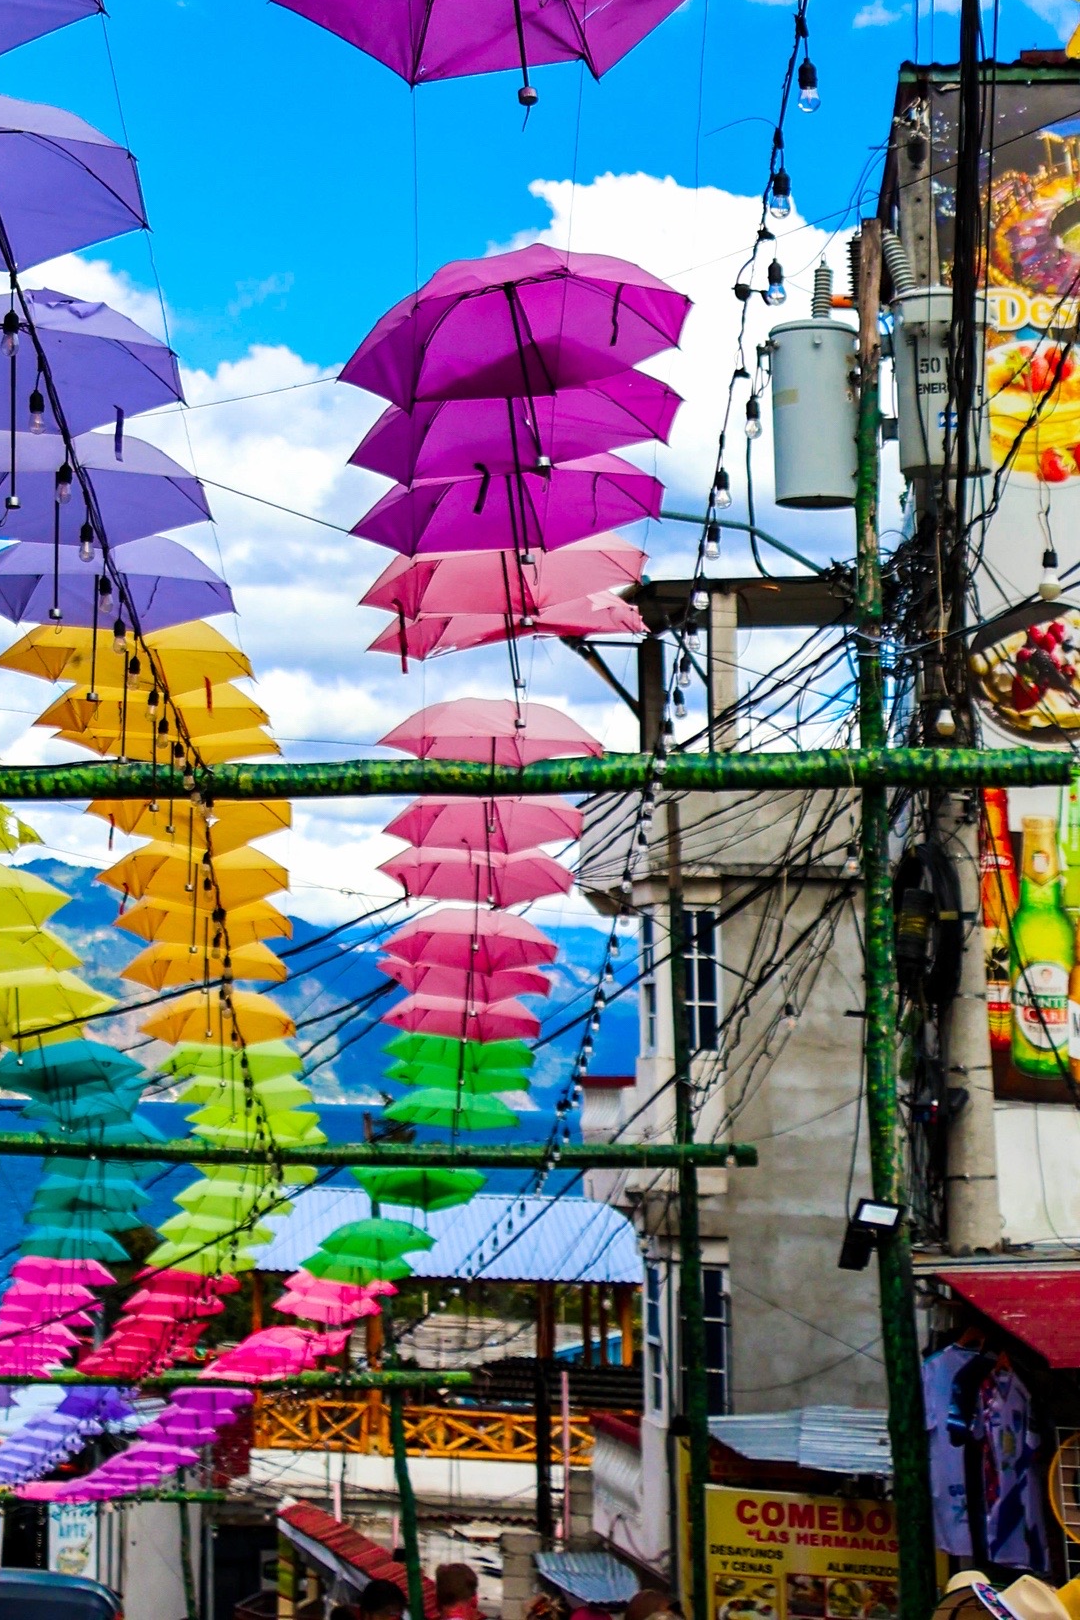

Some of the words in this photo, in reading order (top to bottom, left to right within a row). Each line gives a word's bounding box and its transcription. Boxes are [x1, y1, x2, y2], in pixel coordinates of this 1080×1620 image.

[919, 357, 941, 374] 50
[736, 1499, 892, 1536] COMEDO
[710, 1543, 784, 1560] DESAYUNOS
[731, 1561, 773, 1574] CENAS
[827, 1561, 899, 1577] ALMUERZO
